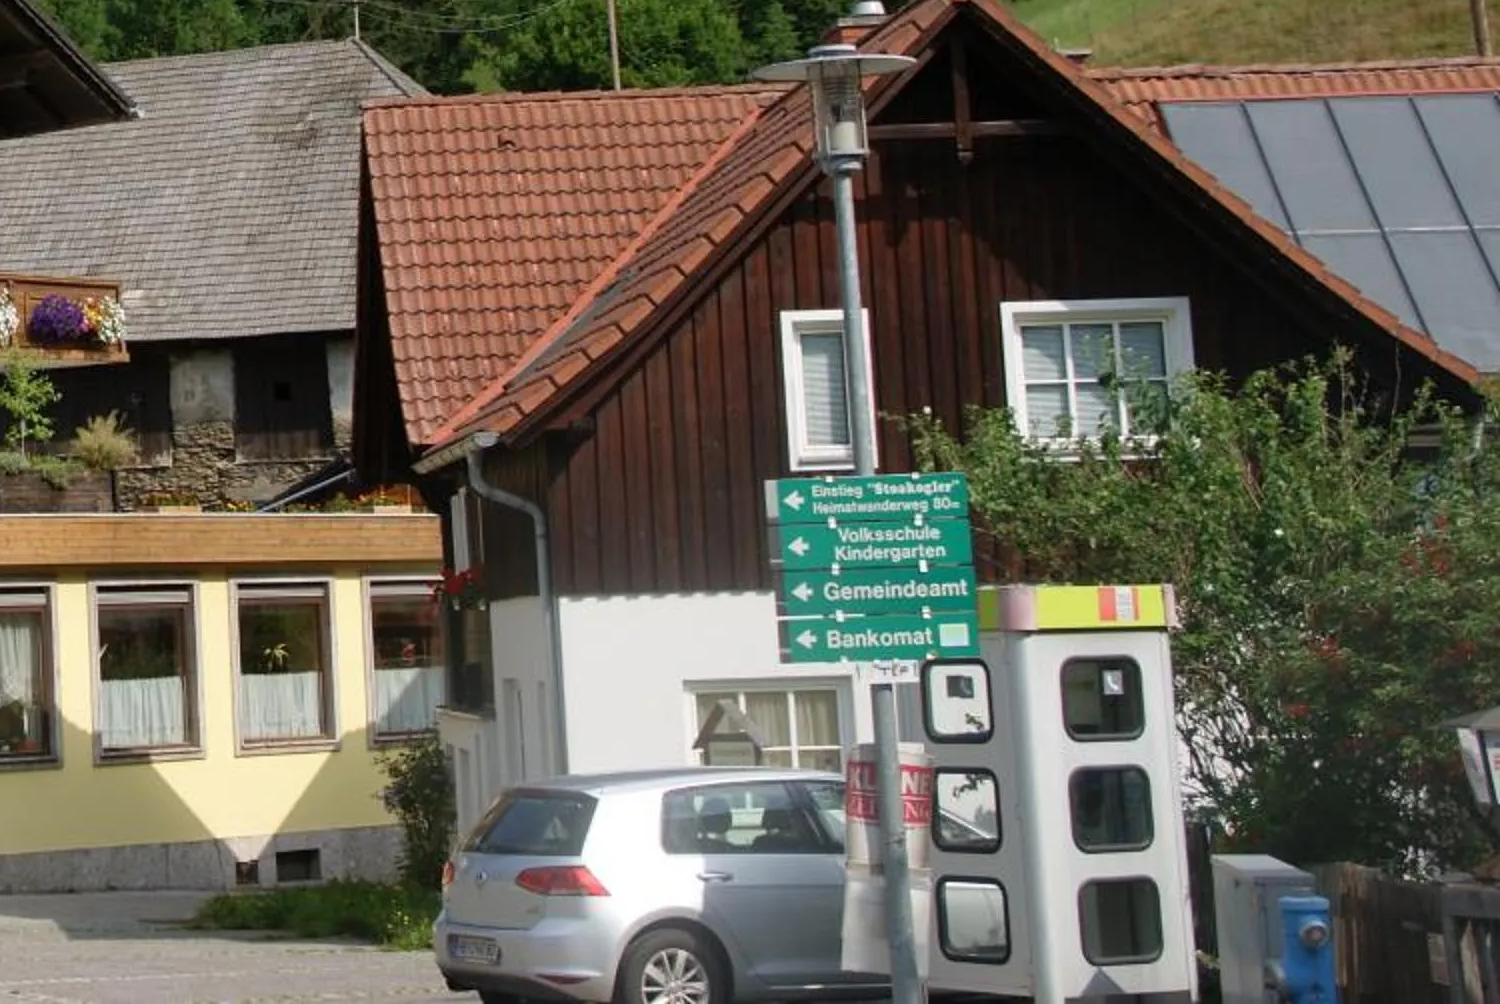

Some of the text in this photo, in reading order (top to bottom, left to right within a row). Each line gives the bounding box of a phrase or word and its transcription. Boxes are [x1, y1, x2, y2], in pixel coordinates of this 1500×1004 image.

[811, 484, 863, 499] Einstieg
[812, 498, 929, 514] Heimatwanderweg
[837, 525, 942, 543] Volksschule
[834, 544, 947, 562] Kindergarten
[822, 578, 968, 602] Gemeindeamt
[826, 627, 933, 649] Bankomat
[848, 764, 933, 795] KLNE
